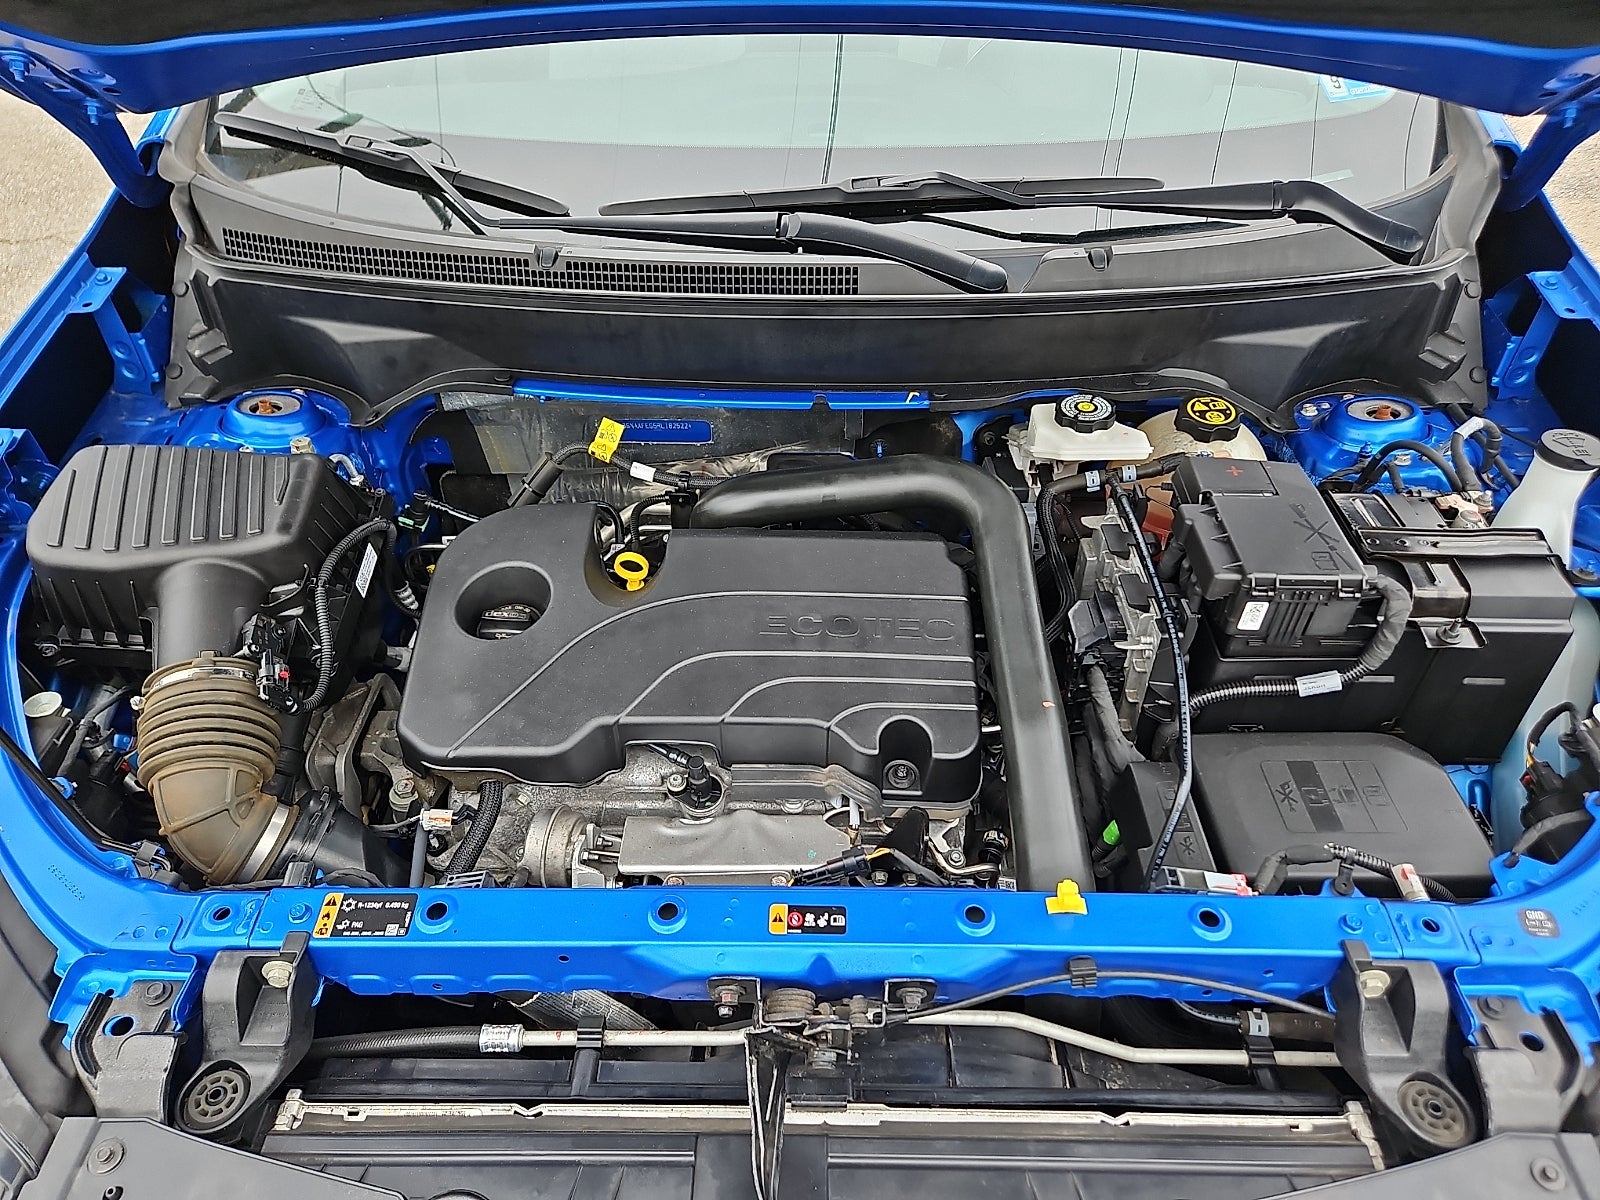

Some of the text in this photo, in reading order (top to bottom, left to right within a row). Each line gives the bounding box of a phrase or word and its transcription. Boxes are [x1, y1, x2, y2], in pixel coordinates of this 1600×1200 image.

[759, 615, 956, 641] ECOTEC
[1526, 910, 1545, 920] GND
[351, 921, 364, 929] PAG
